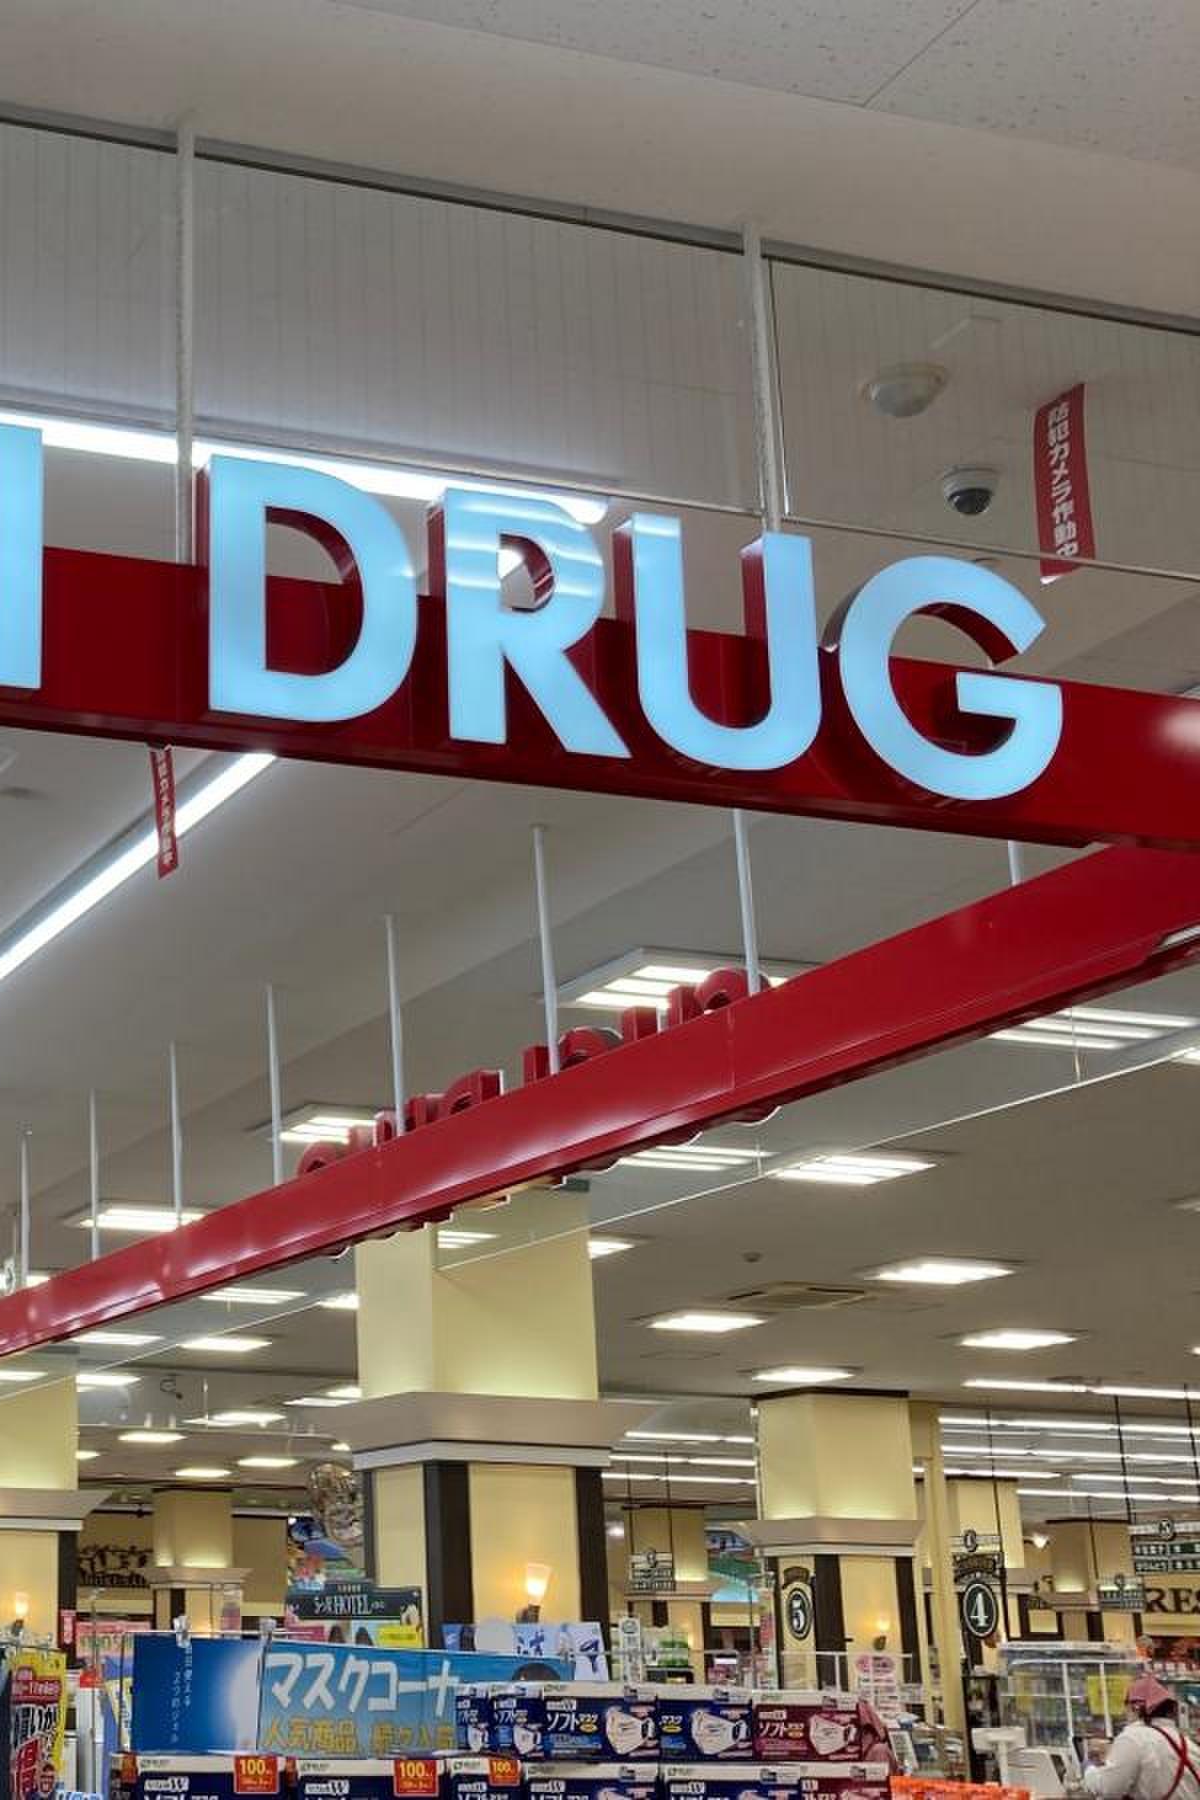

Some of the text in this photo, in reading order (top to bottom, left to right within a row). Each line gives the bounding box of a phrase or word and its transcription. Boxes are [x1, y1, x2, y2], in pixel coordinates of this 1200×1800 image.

[204, 452, 1063, 801] DRUG
[969, 1590, 990, 1627] 4
[240, 1758, 267, 1775] 100
[399, 1761, 426, 1777] 100
